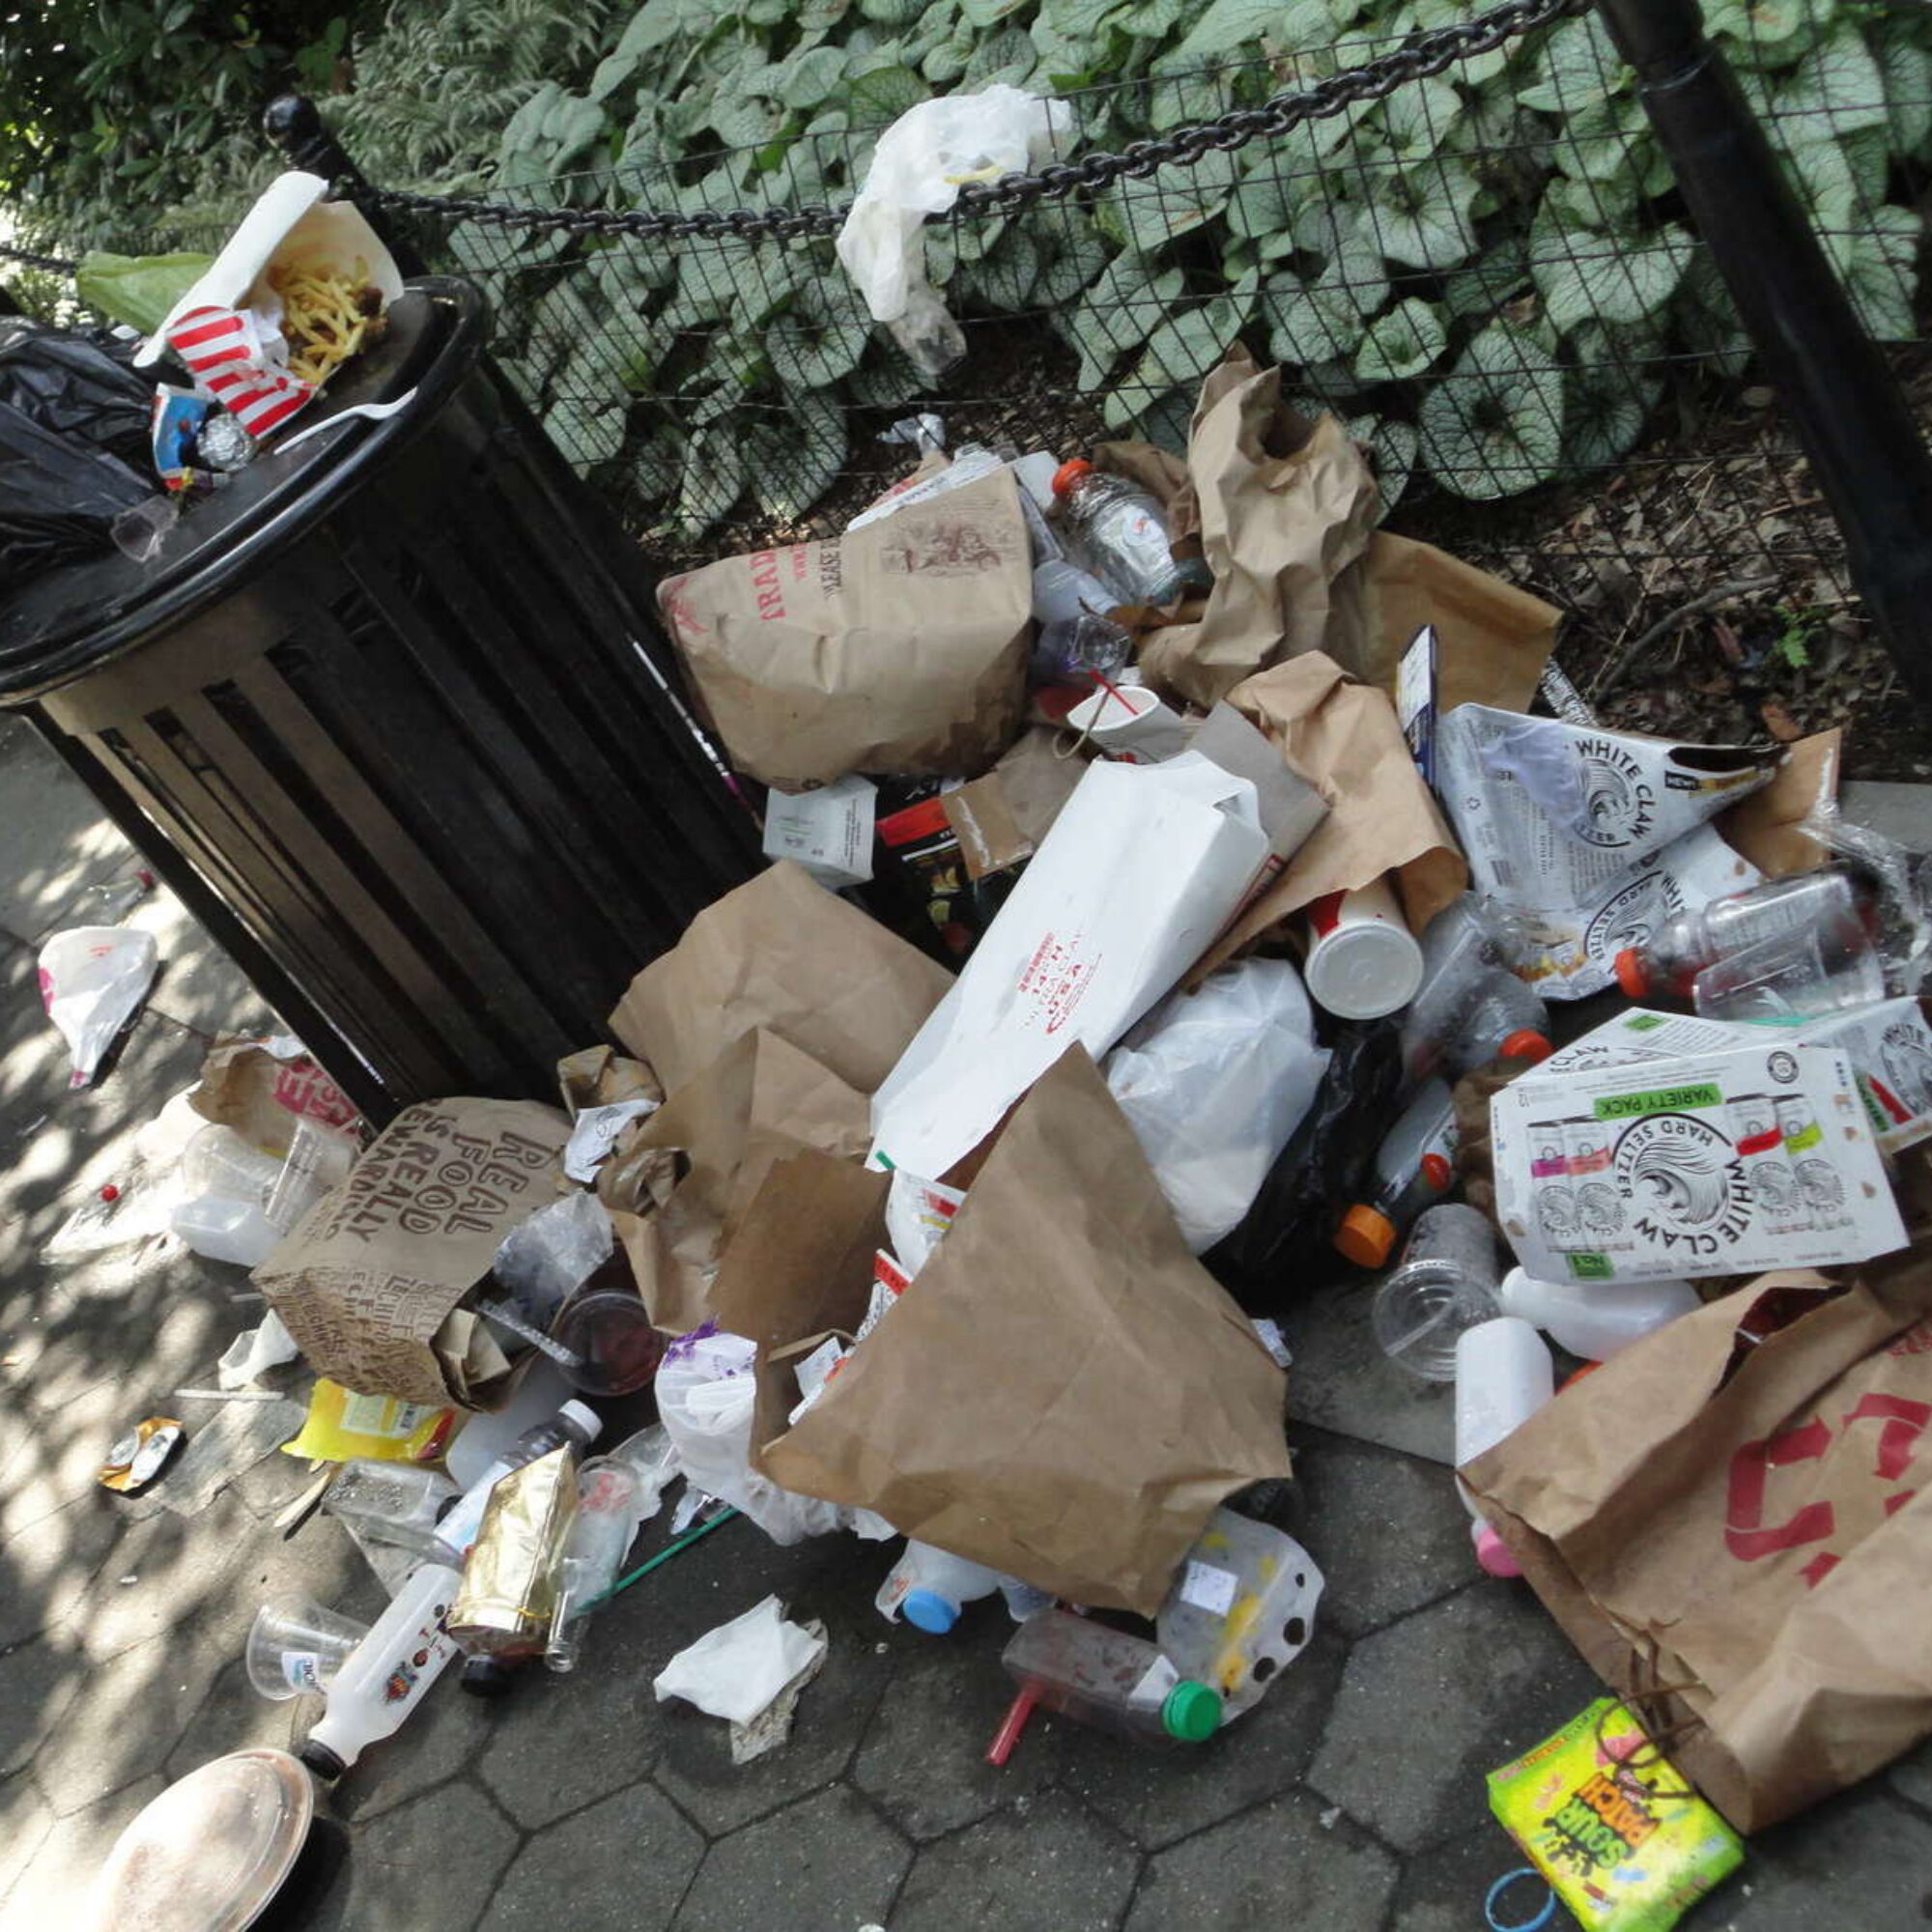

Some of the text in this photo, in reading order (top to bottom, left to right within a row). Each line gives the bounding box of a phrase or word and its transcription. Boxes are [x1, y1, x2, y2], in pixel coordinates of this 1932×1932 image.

[1575, 738, 1656, 839] WHITE CLAW
[423, 1115, 459, 1138] IS
[1603, 1089, 1715, 1116] VARIETY PACK
[345, 1141, 440, 1243] REALLY
[398, 1131, 492, 1235] FOOD
[444, 1130, 557, 1235] REAL
[1617, 1120, 1714, 1199] HARD SELTZER
[1634, 1217, 1719, 1255] CLAW
[1717, 1158, 1753, 1243] WHITE
[1554, 1797, 1629, 1869] SOUR
[1575, 1771, 1661, 1848] PATCH
